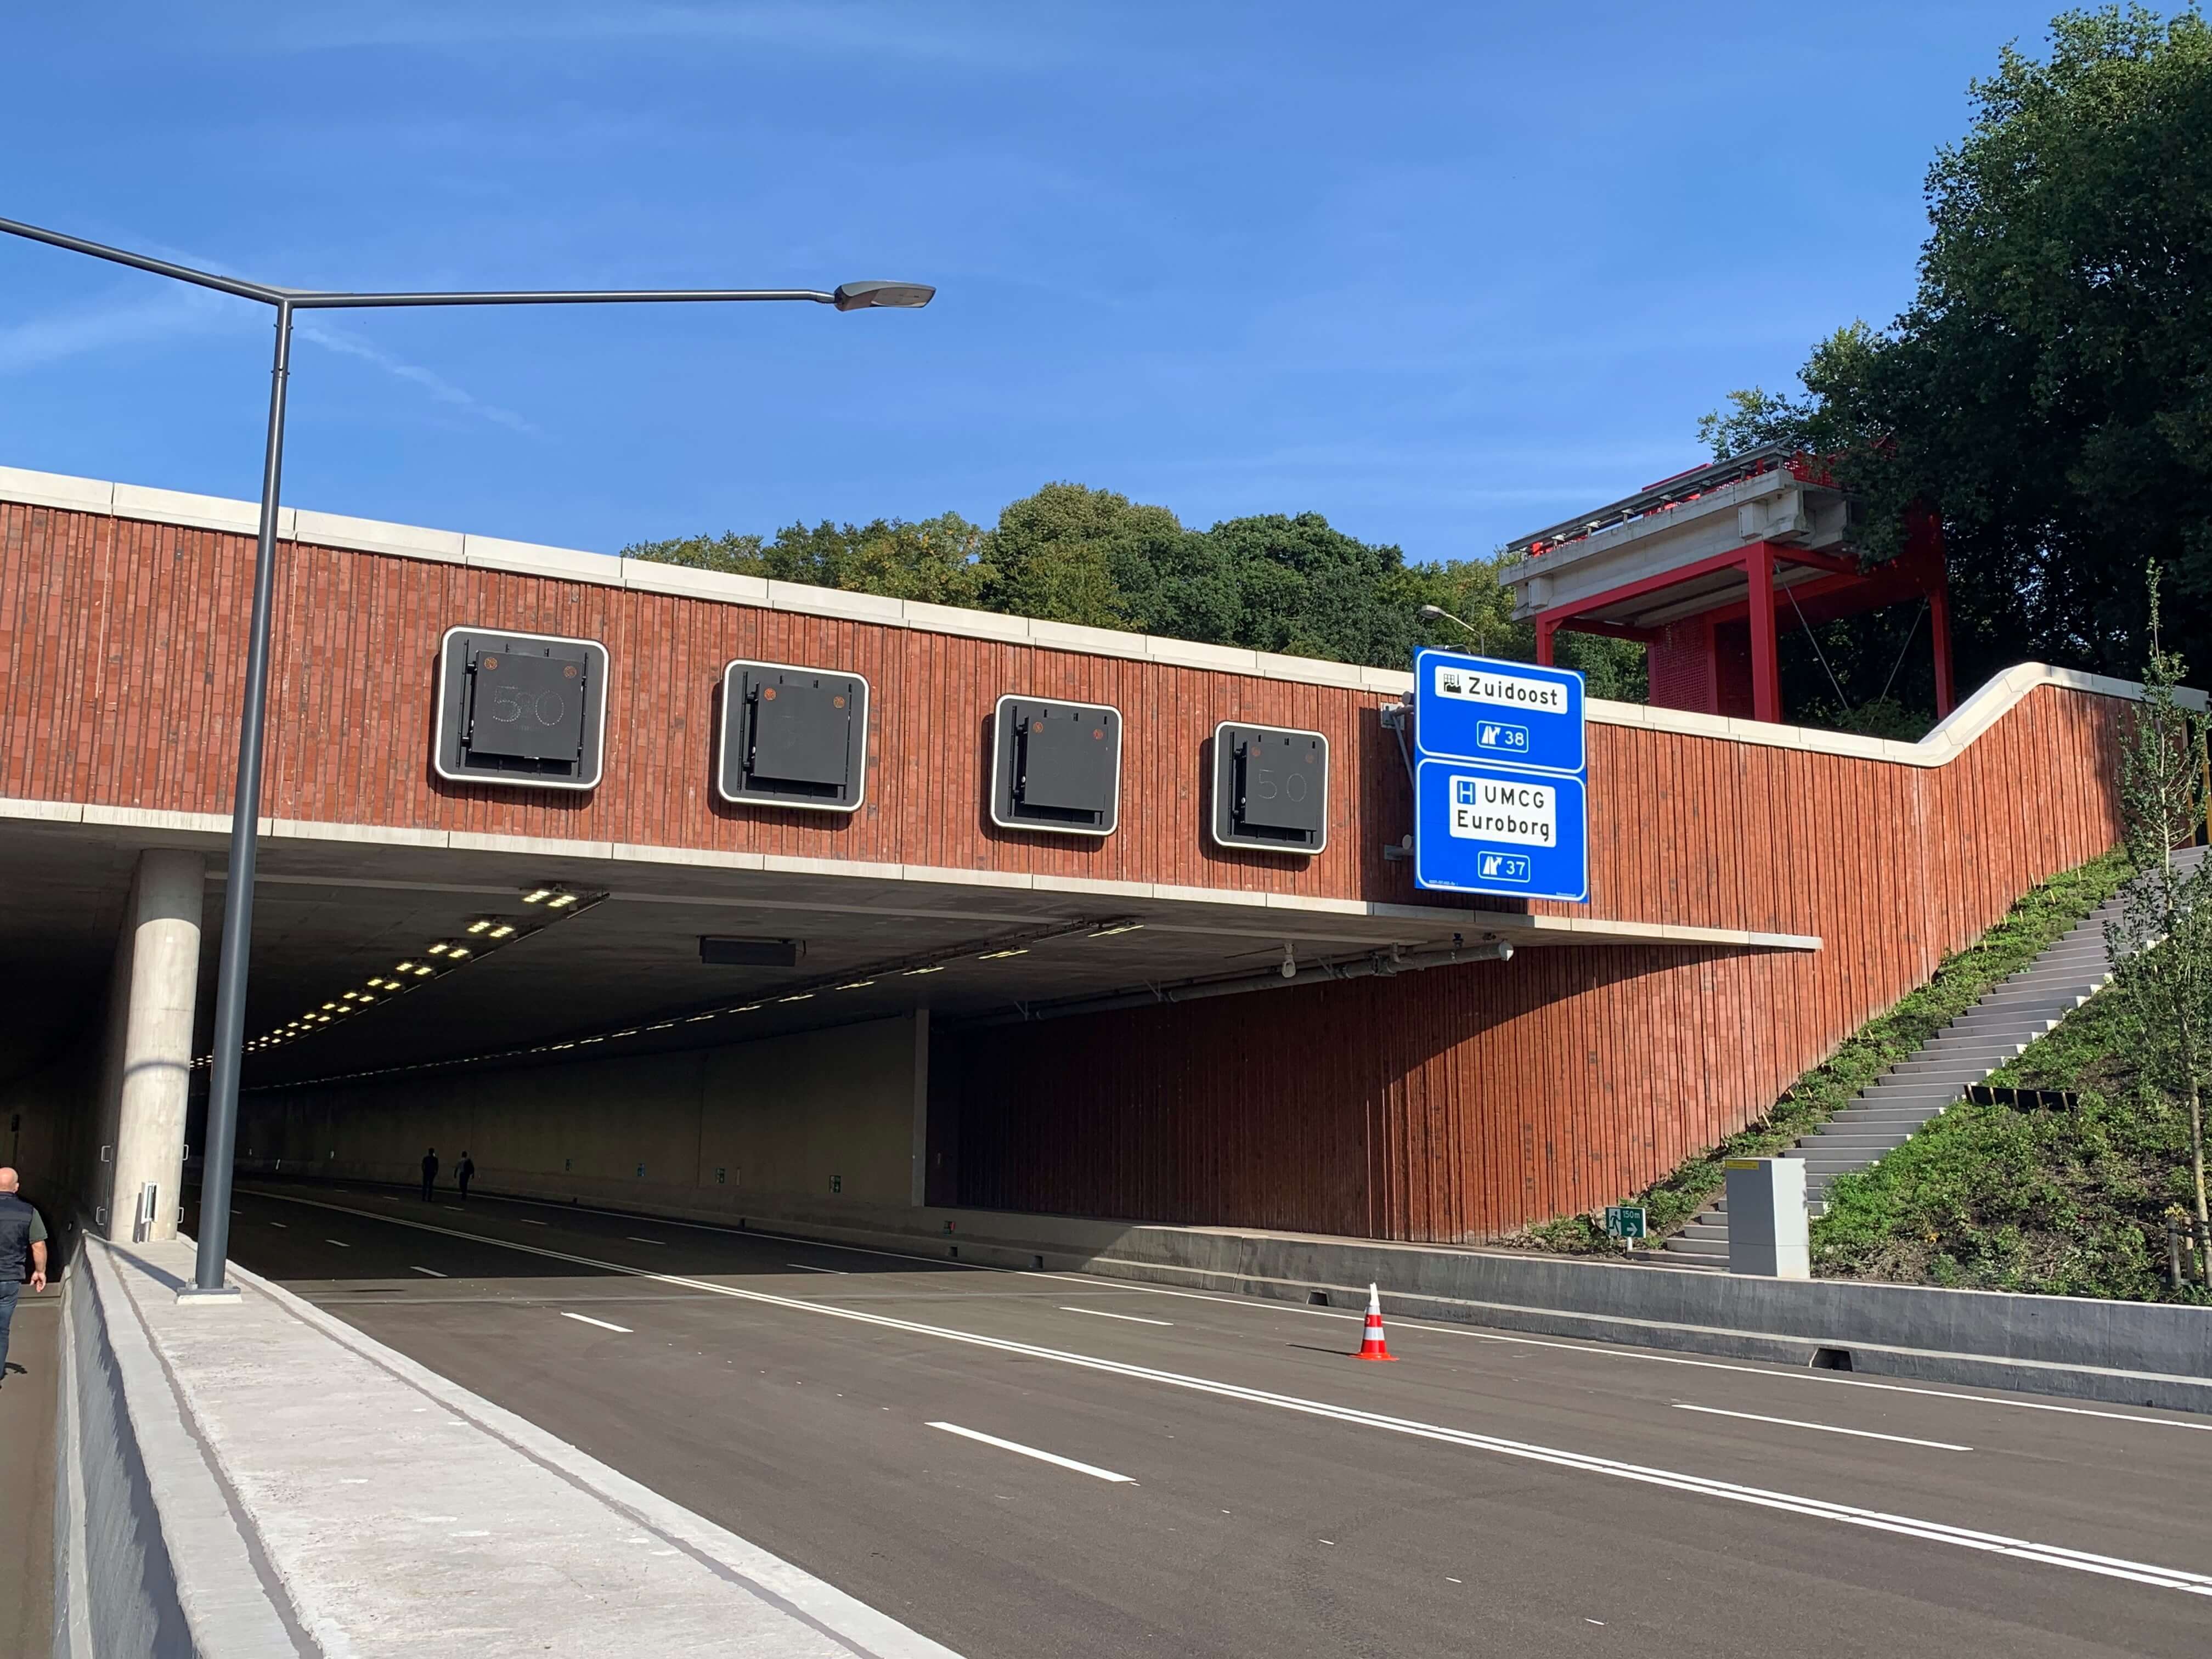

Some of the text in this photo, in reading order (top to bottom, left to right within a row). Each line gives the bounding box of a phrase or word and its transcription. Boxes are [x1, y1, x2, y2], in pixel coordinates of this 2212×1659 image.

[1469, 677, 1558, 706] Zuidoost
[1505, 731, 1524, 746] 38
[1258, 769, 1307, 802] 50
[1485, 786, 1544, 808] UMCG
[1457, 810, 1549, 842] Euroborg
[1506, 861, 1525, 876] 37
